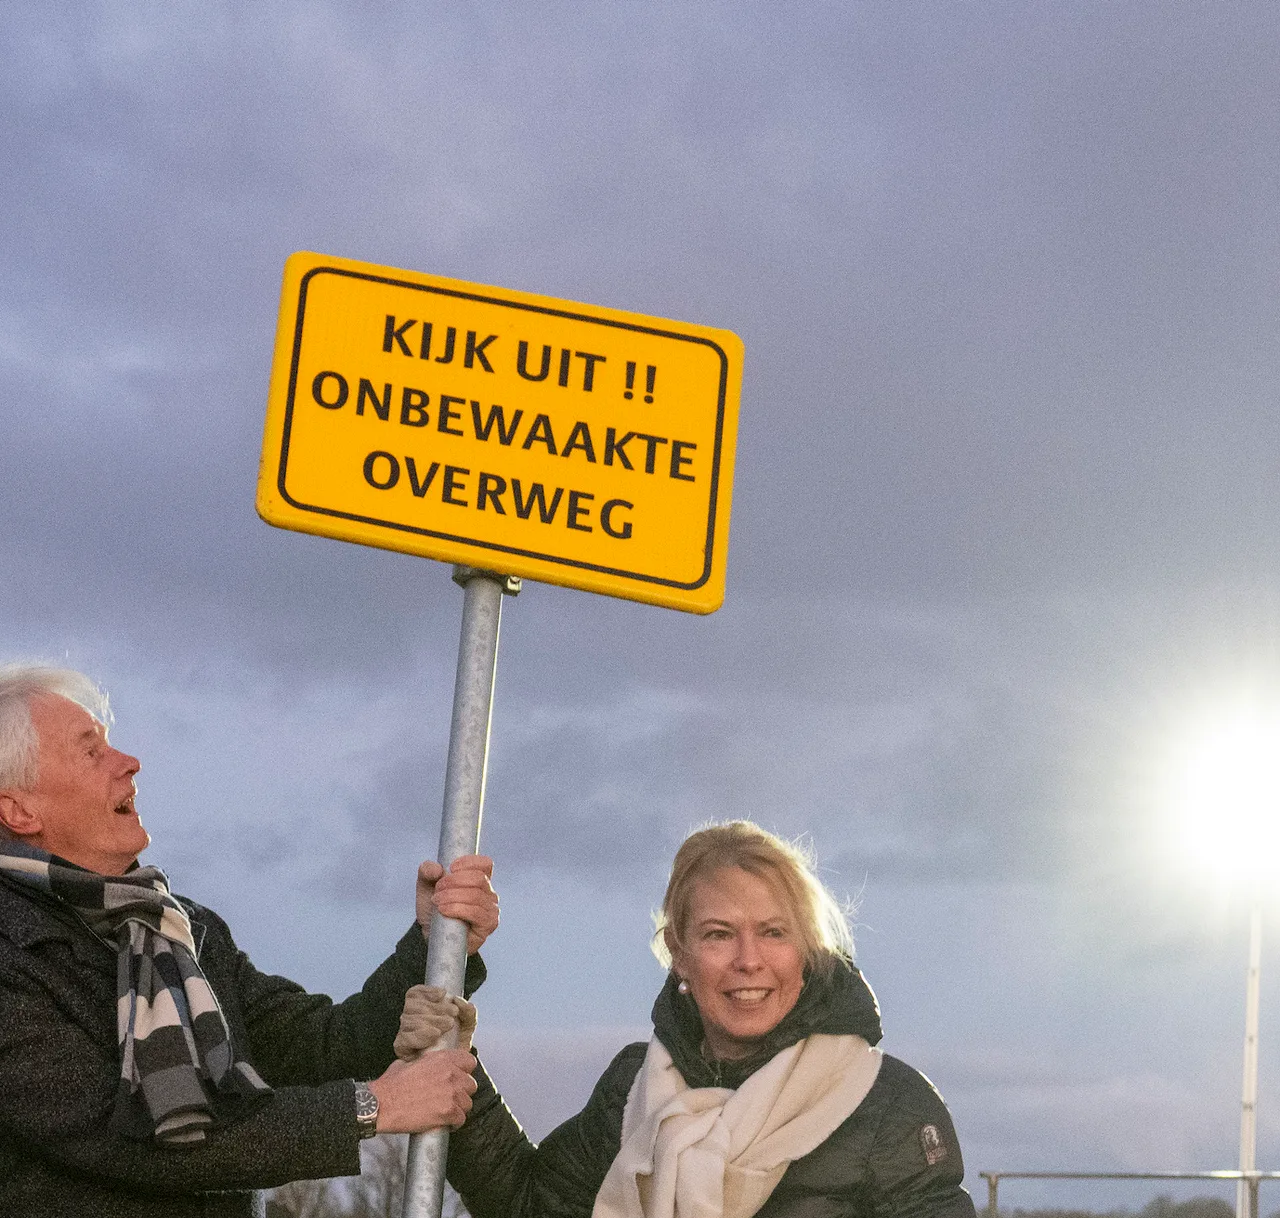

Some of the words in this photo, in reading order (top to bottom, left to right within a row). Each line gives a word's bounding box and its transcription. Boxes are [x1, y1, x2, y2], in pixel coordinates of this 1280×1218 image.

[382, 315, 499, 373] KIJK
[516, 340, 606, 392] UIT
[311, 370, 698, 483] ONBEWAAKTE
[362, 450, 635, 540] OVERWEG
